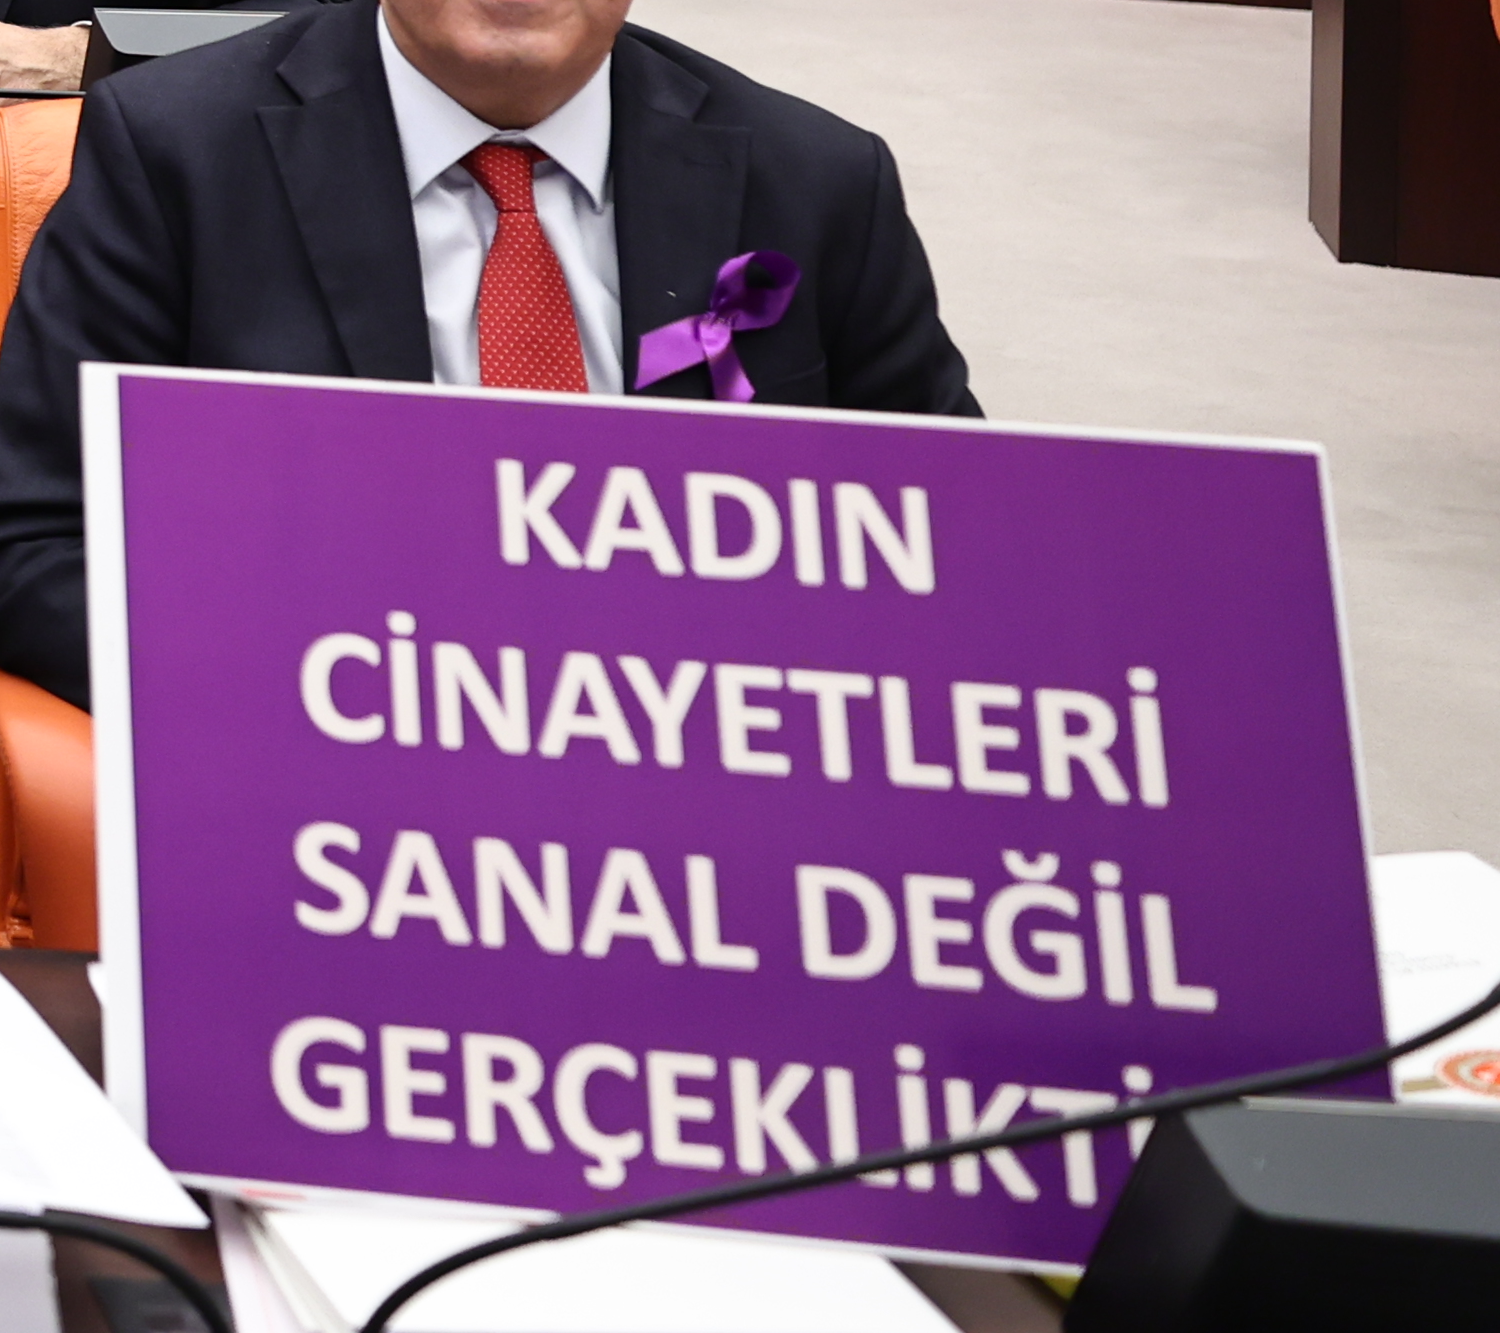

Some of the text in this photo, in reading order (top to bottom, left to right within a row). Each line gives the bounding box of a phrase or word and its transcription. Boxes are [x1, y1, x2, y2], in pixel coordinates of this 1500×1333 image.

[494, 458, 937, 595] KADIN
[299, 611, 1171, 807] CİNAYETLERİ
[291, 821, 1219, 1015] SANAL DEĞİL
